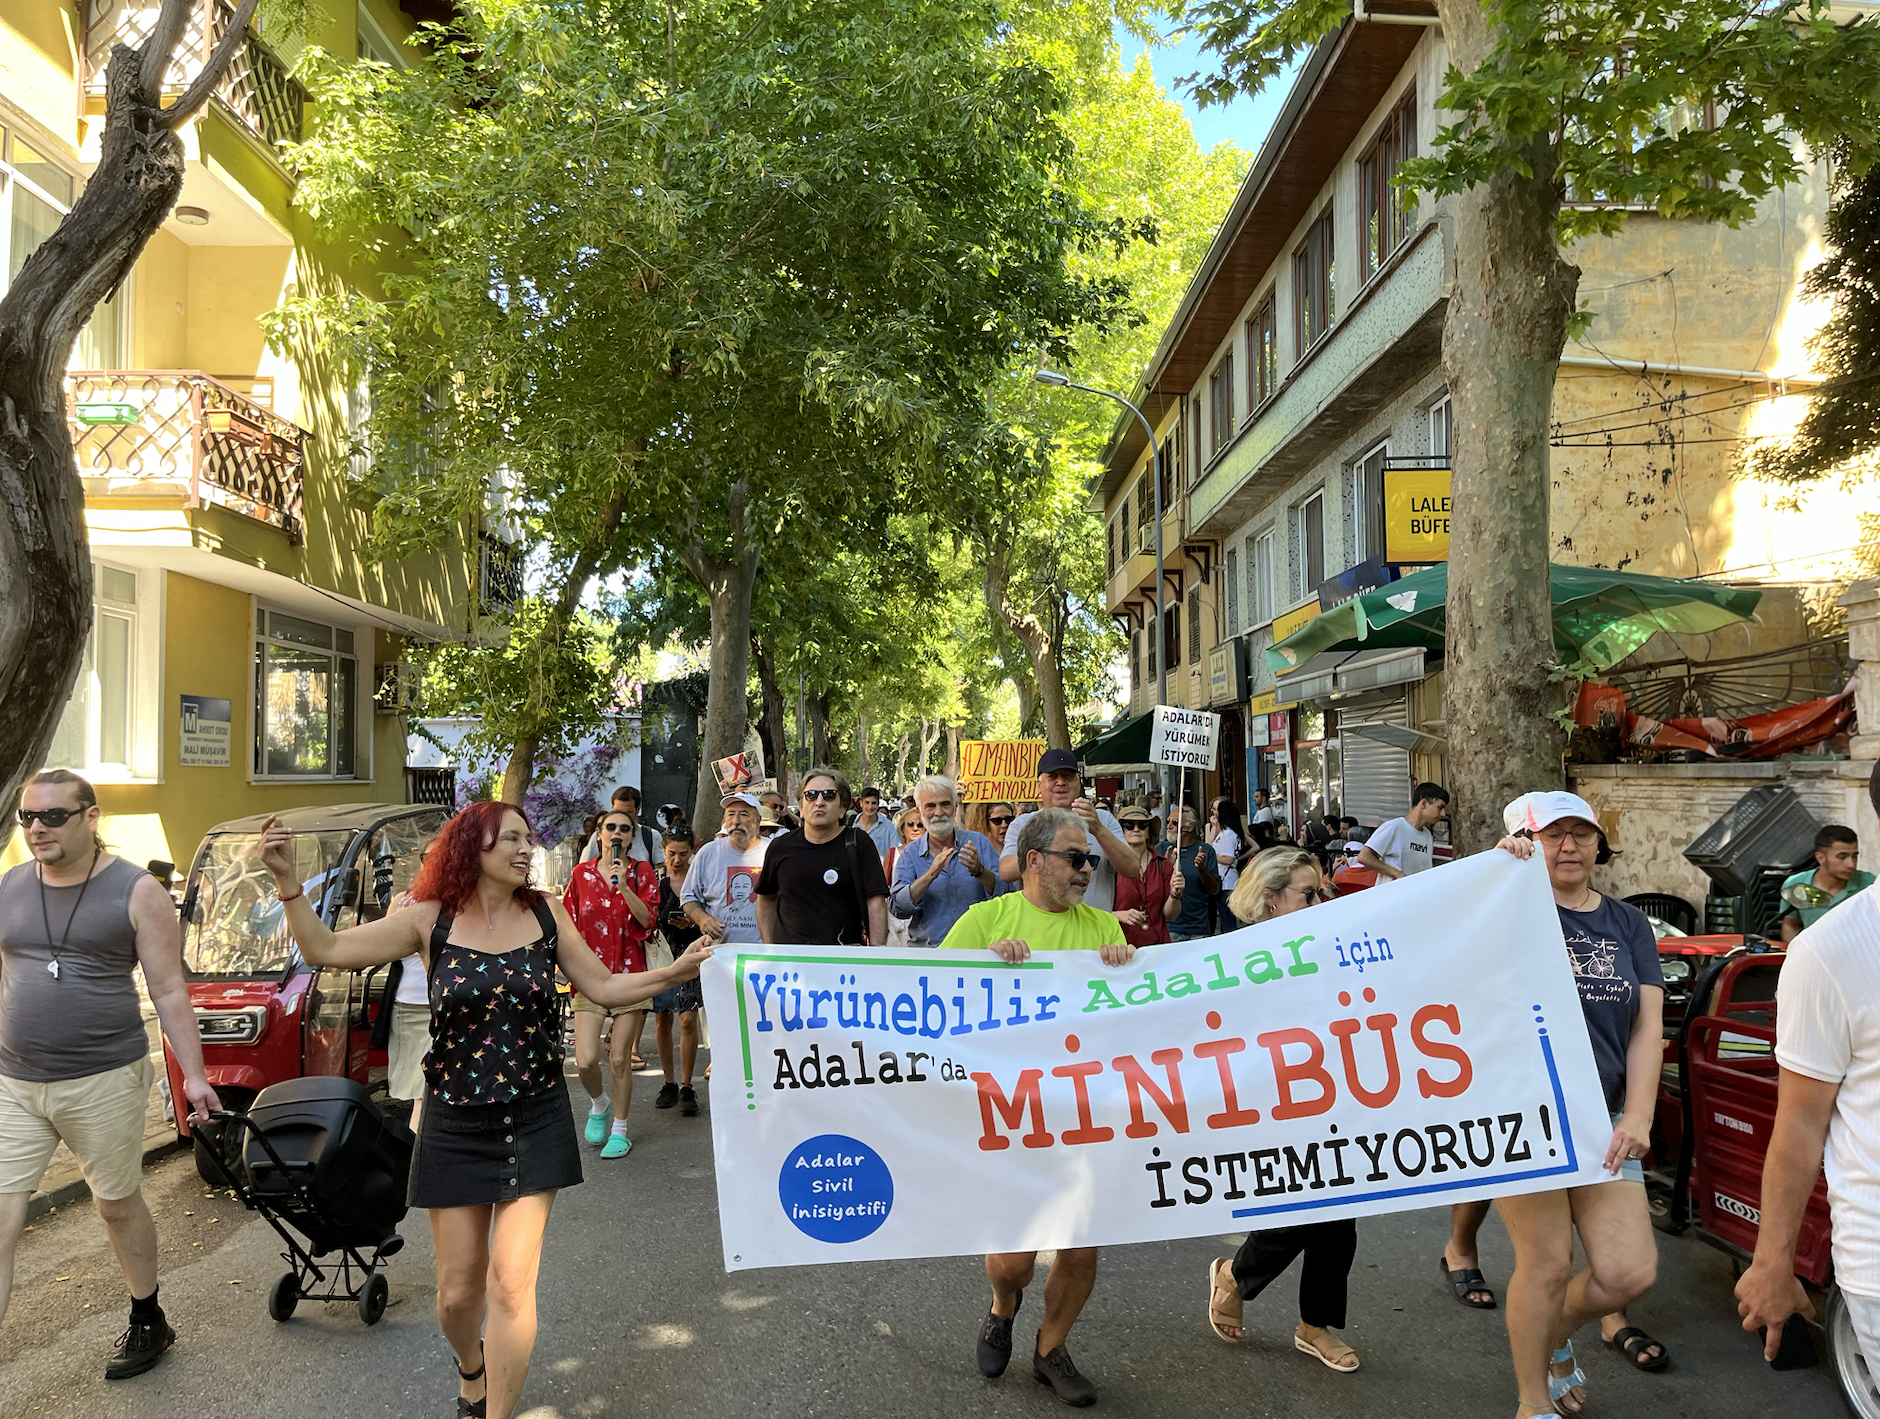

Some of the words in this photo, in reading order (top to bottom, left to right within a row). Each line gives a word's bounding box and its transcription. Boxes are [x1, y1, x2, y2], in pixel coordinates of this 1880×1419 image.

[1411, 497, 1451, 512] LALE
[1411, 515, 1450, 534] BÜFE
[1164, 728, 1211, 747] YÜRÜMEK
[1161, 745, 1211, 766] İSTİYORUZ
[1410, 842, 1428, 854] mavi
[749, 971, 1060, 1039] Yürünebilir
[1081, 935, 1319, 1013] Adalar
[1335, 931, 1394, 973] için
[970, 986, 1474, 1151] MİNİBÜS
[794, 1152, 865, 1169] Adalar
[811, 1177, 853, 1193] Sivil
